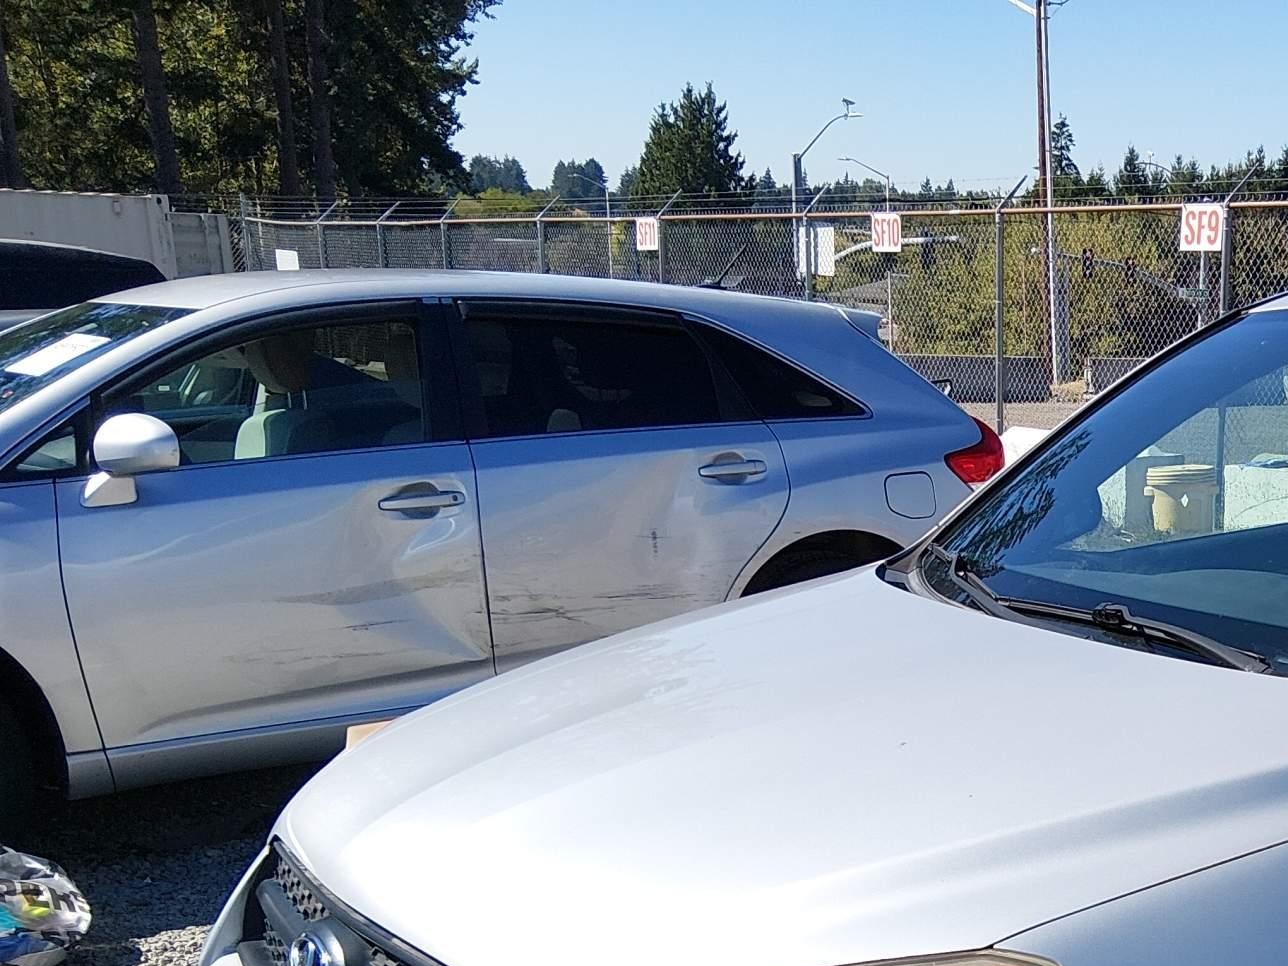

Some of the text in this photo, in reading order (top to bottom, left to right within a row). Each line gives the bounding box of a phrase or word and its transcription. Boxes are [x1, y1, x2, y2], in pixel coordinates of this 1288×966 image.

[638, 221, 656, 246] SF11
[873, 218, 900, 247] SF10
[1184, 210, 1220, 245] SF9
